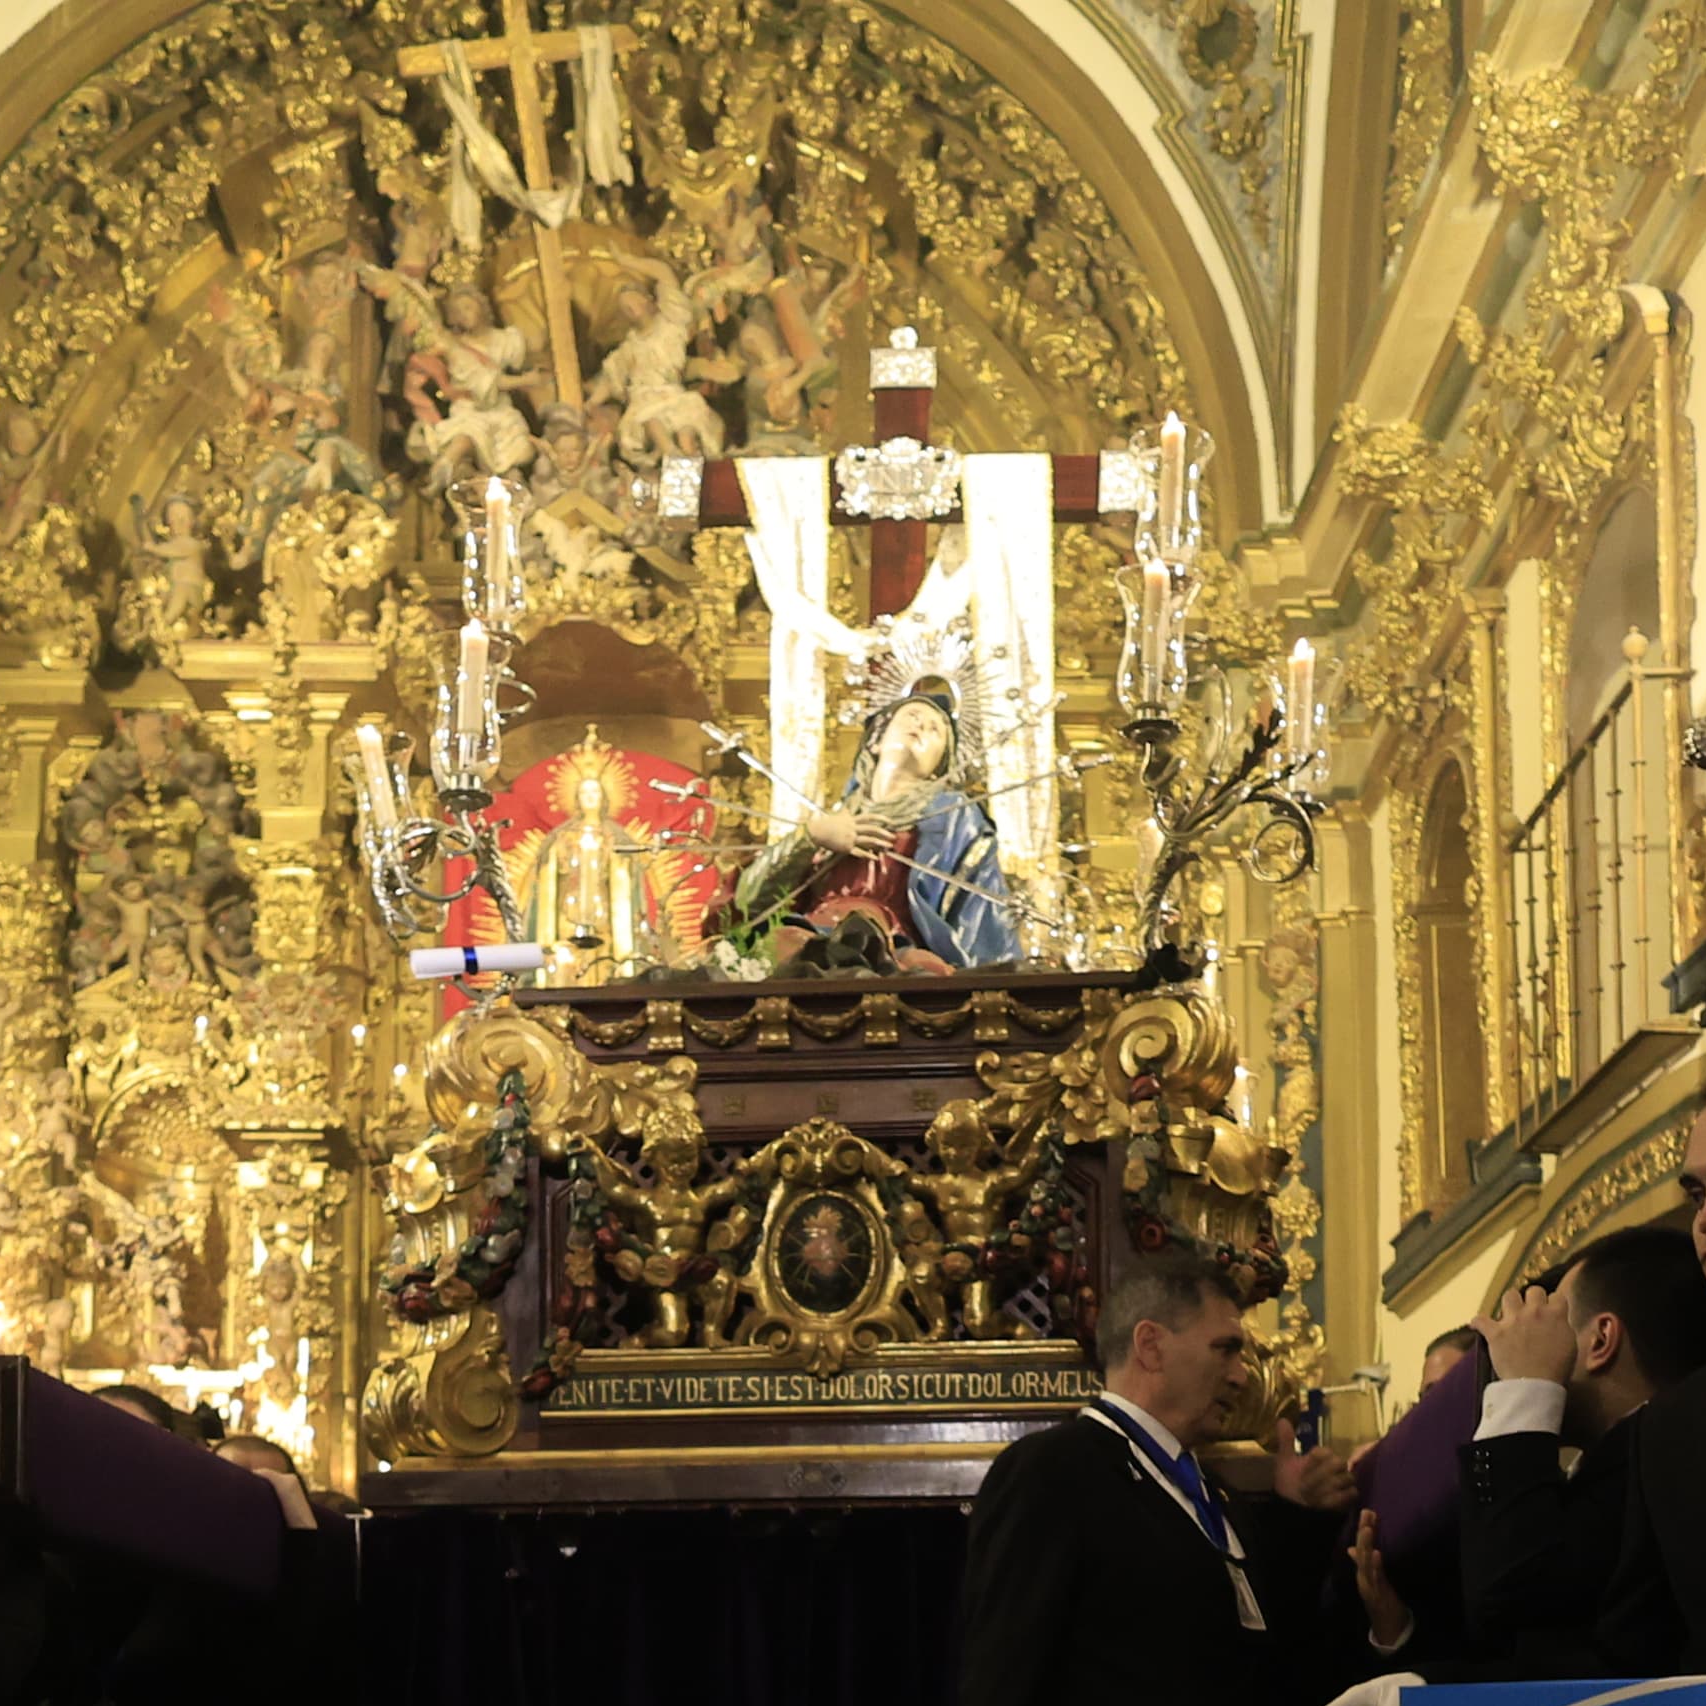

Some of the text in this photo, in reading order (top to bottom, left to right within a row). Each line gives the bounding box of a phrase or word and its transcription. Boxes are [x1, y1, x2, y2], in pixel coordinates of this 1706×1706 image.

[628, 1379, 655, 1403] ET
[659, 1377, 743, 1403] VIDETE
[746, 1376, 771, 1402] SI
[774, 1375, 814, 1401] EST
[820, 1373, 893, 1400] DOLOR
[895, 1373, 964, 1400] SICUT
[967, 1371, 1041, 1398] DOLOR
